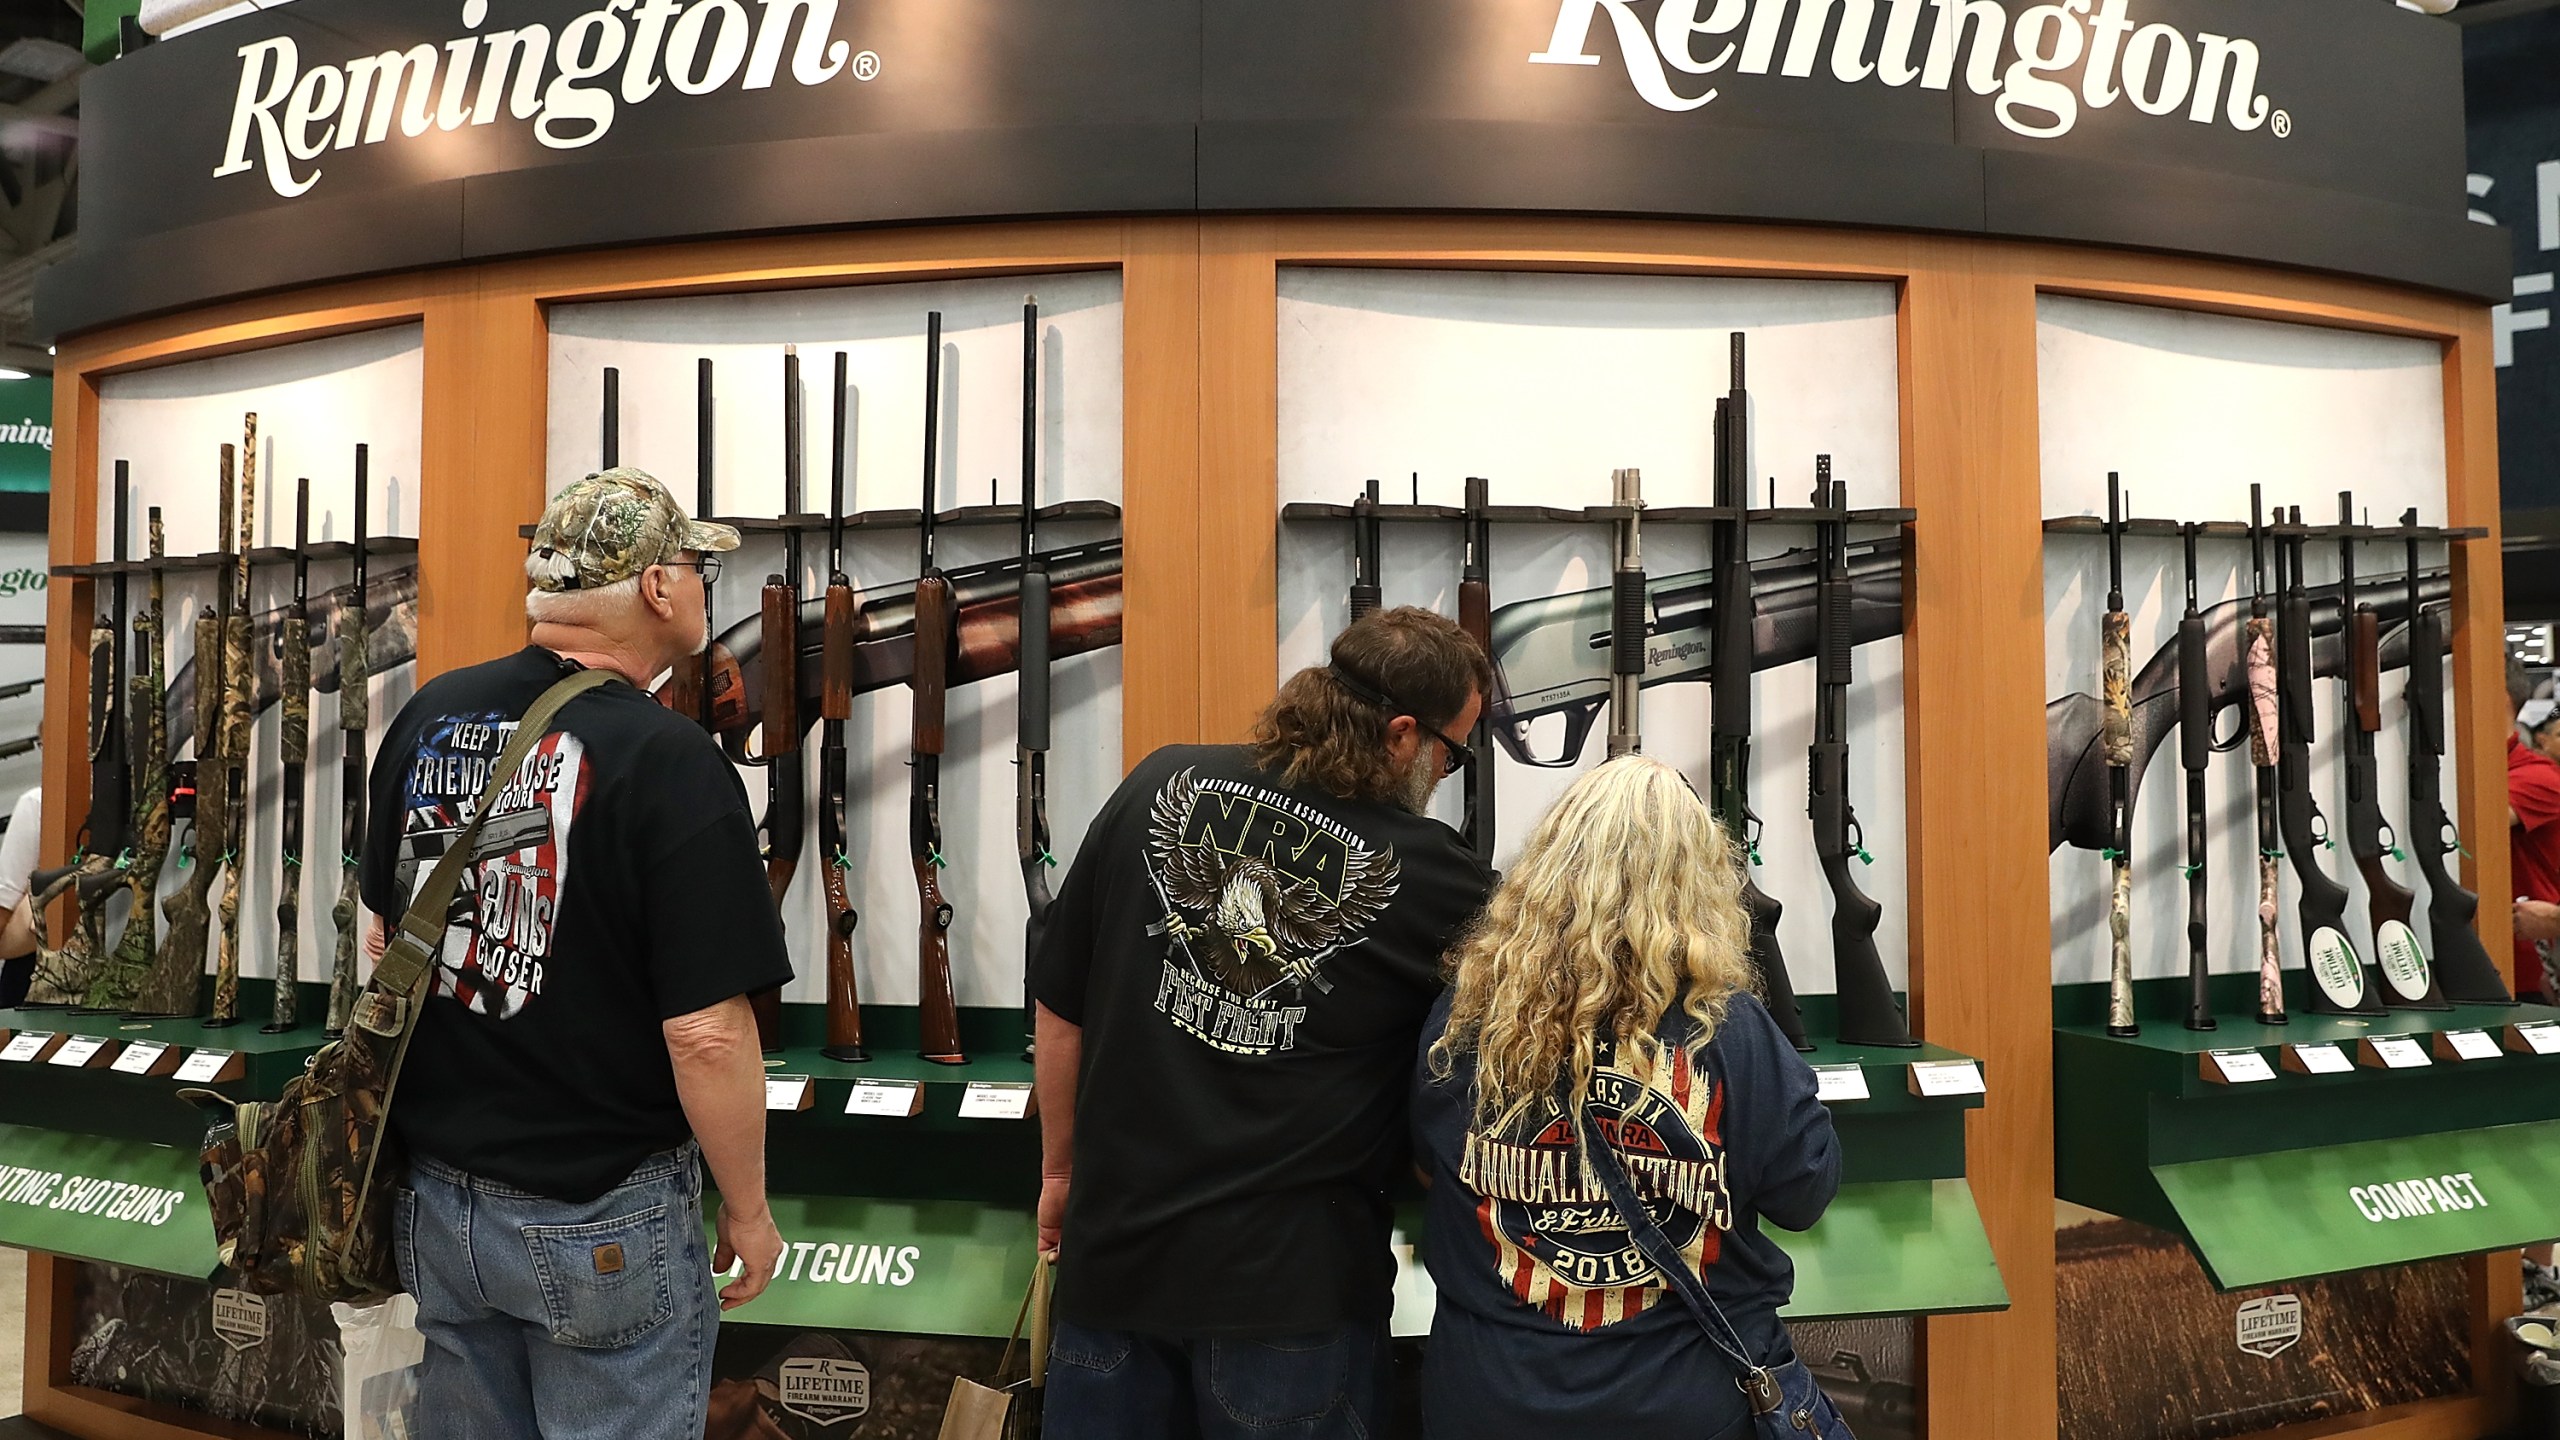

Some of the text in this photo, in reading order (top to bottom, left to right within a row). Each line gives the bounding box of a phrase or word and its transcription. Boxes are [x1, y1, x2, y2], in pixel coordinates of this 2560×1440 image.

[1647, 641, 1707, 667] Remington
[451, 722, 491, 751] KEEP
[497, 791, 530, 813] YOUR
[1199, 778, 1366, 852] NATIONAL RIFLE ASSOCIATION
[501, 860, 551, 879] Remington
[1178, 791, 1349, 908] NRA
[481, 869, 551, 957] GUNS
[476, 934, 543, 995] CLOSER
[2323, 946, 2346, 989] LIFETIME
[2389, 940, 2412, 981] LIFETIME
[1154, 959, 1306, 1051] FIST FIGHT
[1180, 968, 1278, 1010] BECAUSE YOU CAN'T
[1171, 1015, 1272, 1056] TYRANNY
[1606, 1122, 1652, 1146] NRA
[49, 1176, 185, 1226] SHOTGUNS
[1459, 1130, 1733, 1232] ANNUAL METINGS
[2349, 1172, 2489, 1222] COMPACT
[1552, 1248, 1646, 1282] 2018
[216, 1304, 263, 1325] LIFETIME
[2241, 1310, 2298, 1332] LIFETIME
[786, 1376, 865, 1395] LIFETIME
[787, 1392, 863, 1404] FIREARM WARRANTY
